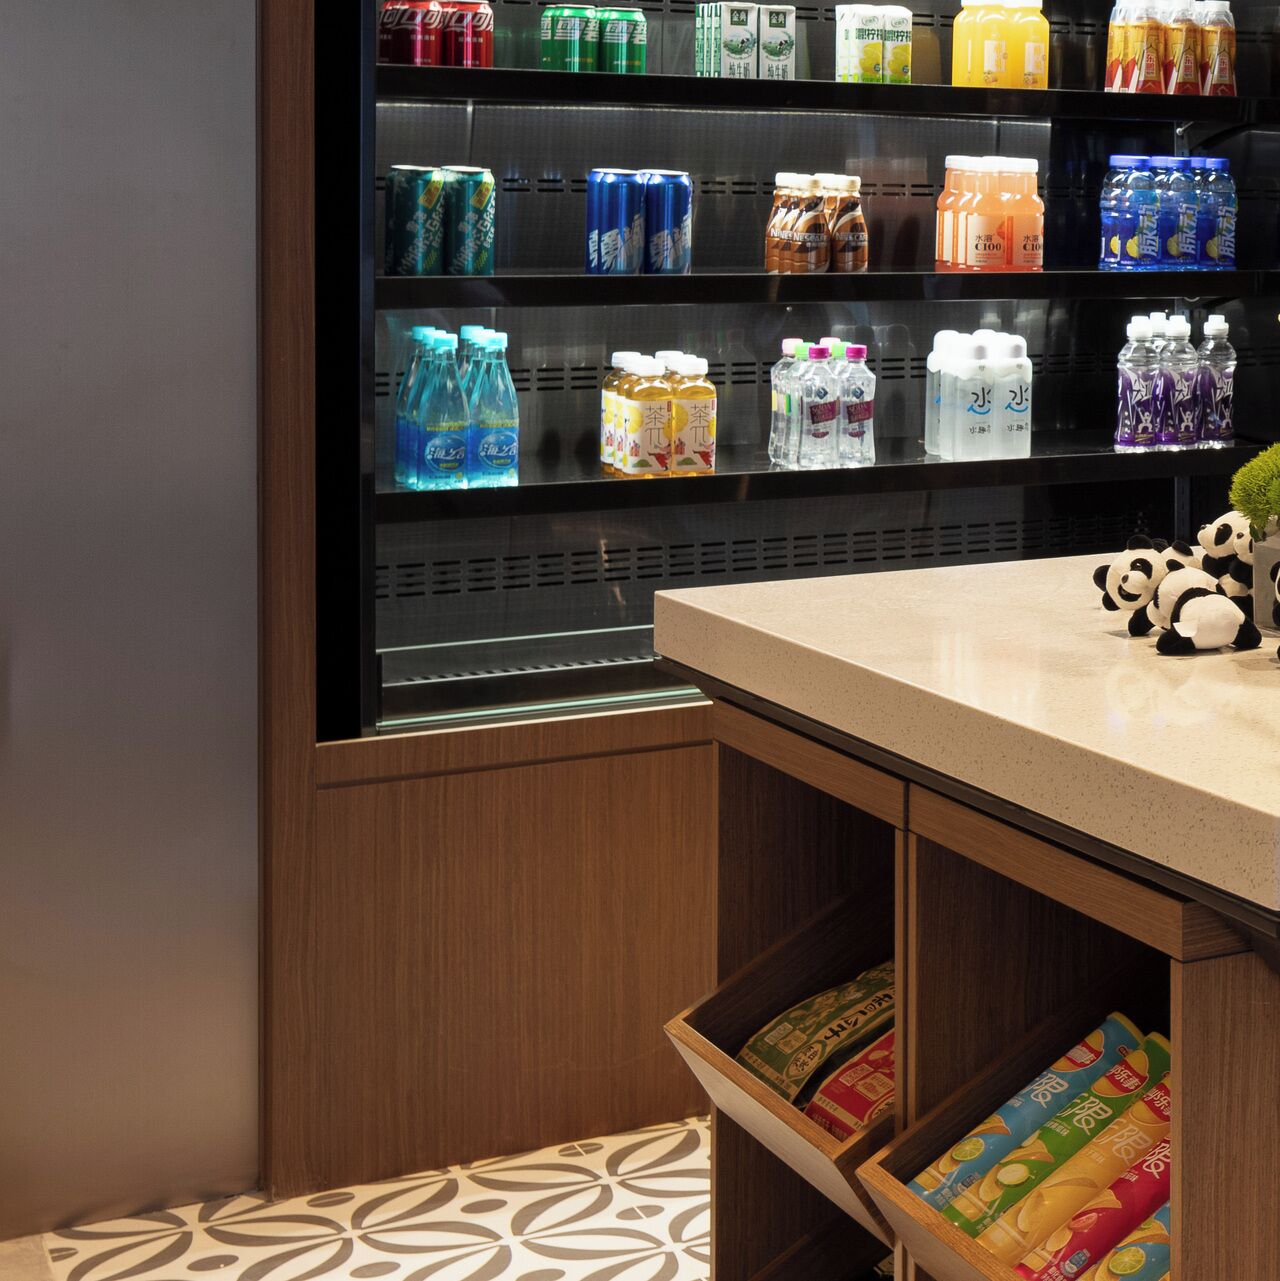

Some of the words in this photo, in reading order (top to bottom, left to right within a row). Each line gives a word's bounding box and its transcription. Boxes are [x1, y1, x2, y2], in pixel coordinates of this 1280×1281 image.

[975, 235, 993, 243] 水溶
[975, 243, 1001, 252] C100
[1023, 243, 1041, 252] C10
